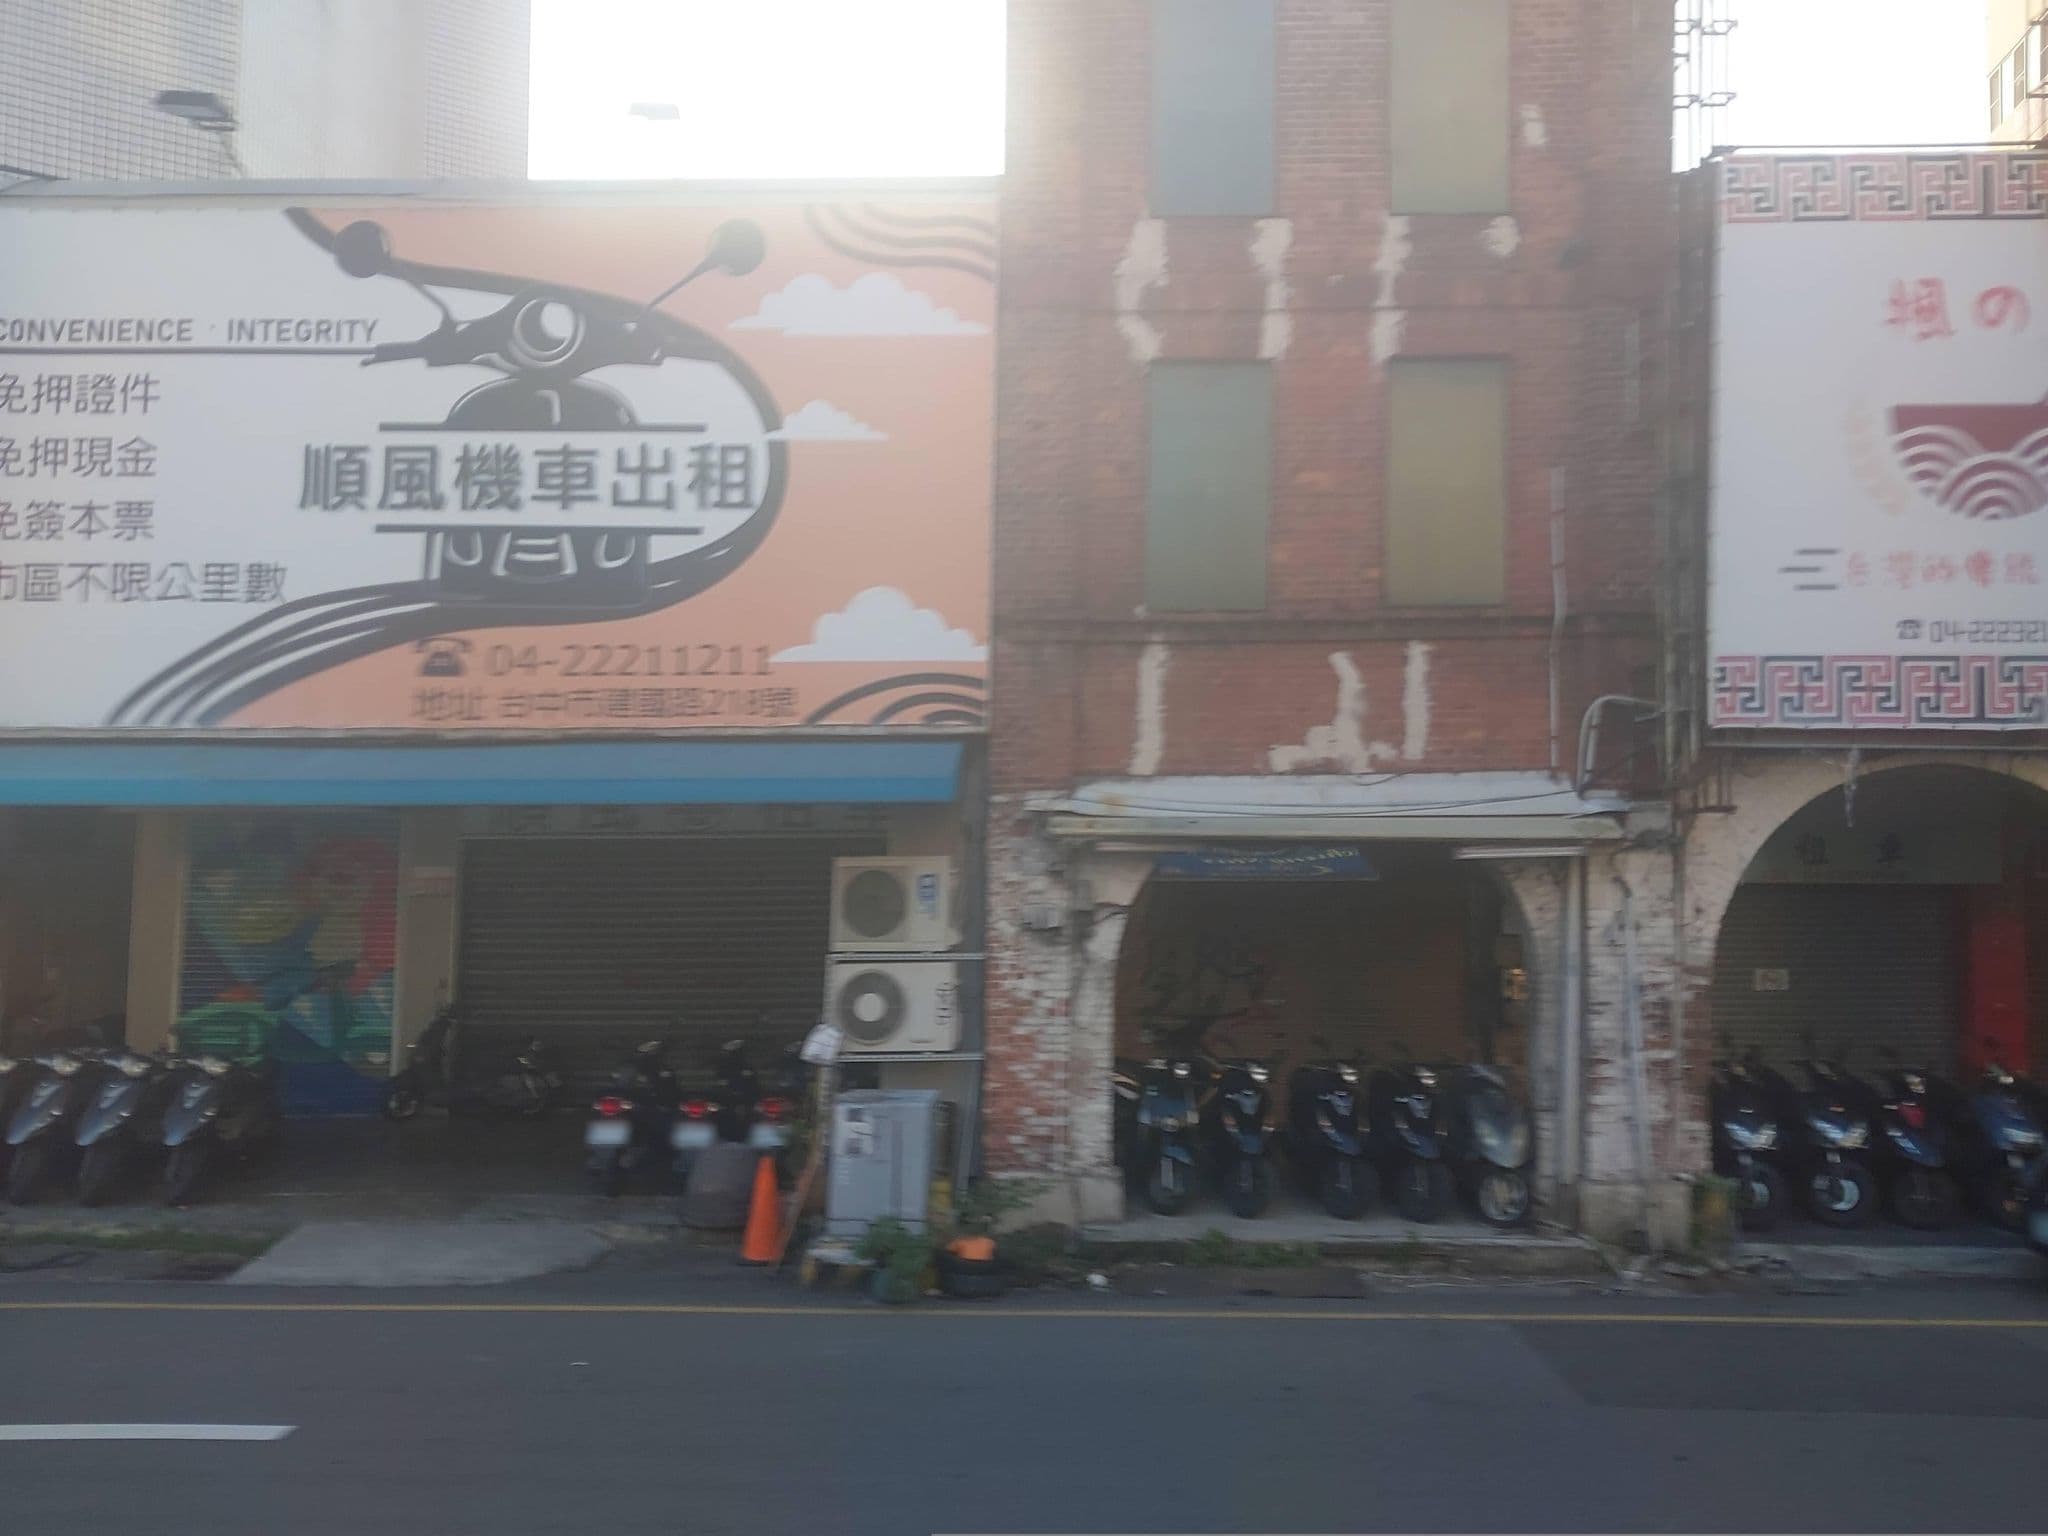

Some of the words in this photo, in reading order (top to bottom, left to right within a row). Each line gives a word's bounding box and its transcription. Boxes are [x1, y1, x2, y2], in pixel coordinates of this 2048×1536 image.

[227, 318, 379, 343] INTEGRITY
[0, 373, 161, 415] 免押證件
[300, 442, 752, 512] 順風機車出租
[486, 644, 772, 676] 04-22211211
